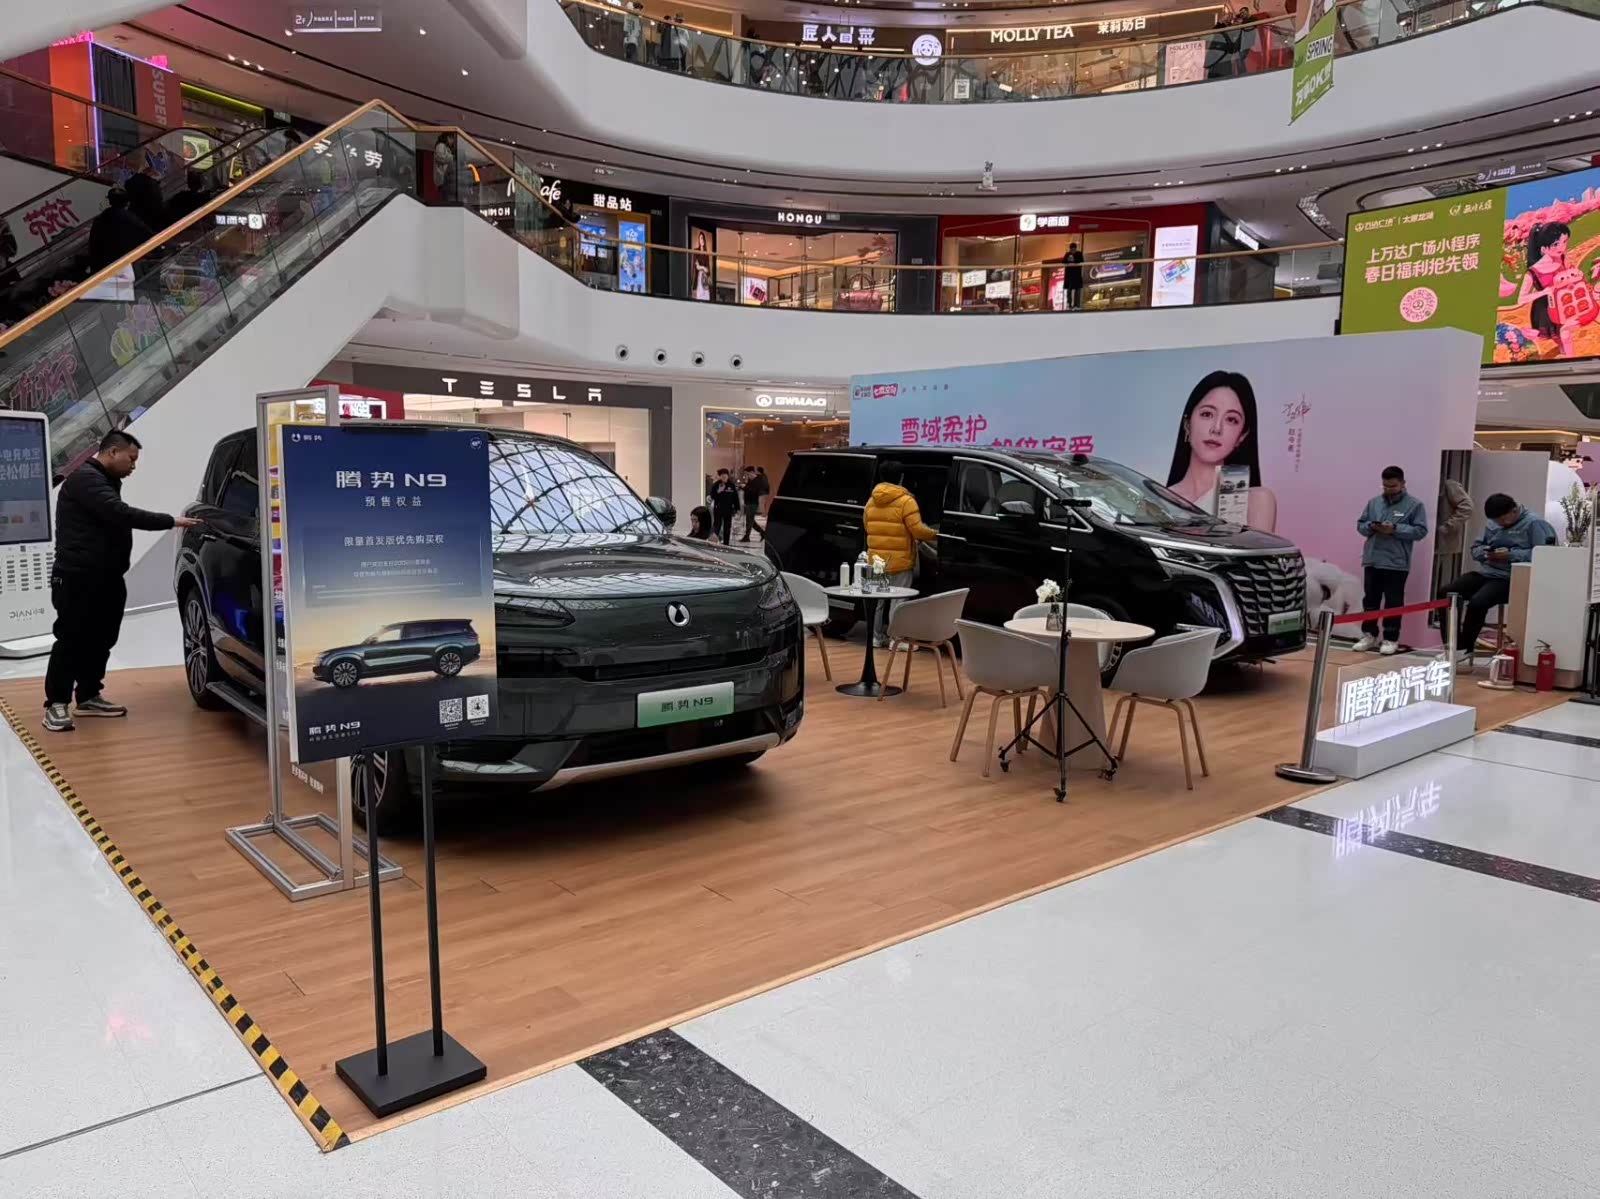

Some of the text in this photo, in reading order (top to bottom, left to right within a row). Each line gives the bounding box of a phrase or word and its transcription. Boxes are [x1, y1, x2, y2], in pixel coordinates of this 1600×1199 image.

[990, 25, 1074, 44] MOLLY TEA
[1097, 17, 1147, 35] 茉莉奶白
[1307, 37, 1333, 60] SPRING
[152, 69, 167, 126] SUPER
[593, 194, 632, 212] 甜品站
[777, 211, 822, 225] HONGU
[1366, 233, 1481, 265] 上万达广场小程序
[1364, 252, 1480, 284] 春日福利抢先领
[442, 376, 602, 402] TESLA
[901, 414, 988, 444] 雪域柔护
[0, 447, 41, 462] 电充电宝
[336, 471, 447, 489] 腾势 N9
[365, 496, 423, 508] 预售权益
[343, 534, 445, 547] 限量首发版优先购买权
[1340, 659, 1451, 724] 腾势汽车
[693, 696, 714, 708] N9
[340, 721, 361, 731] N9
